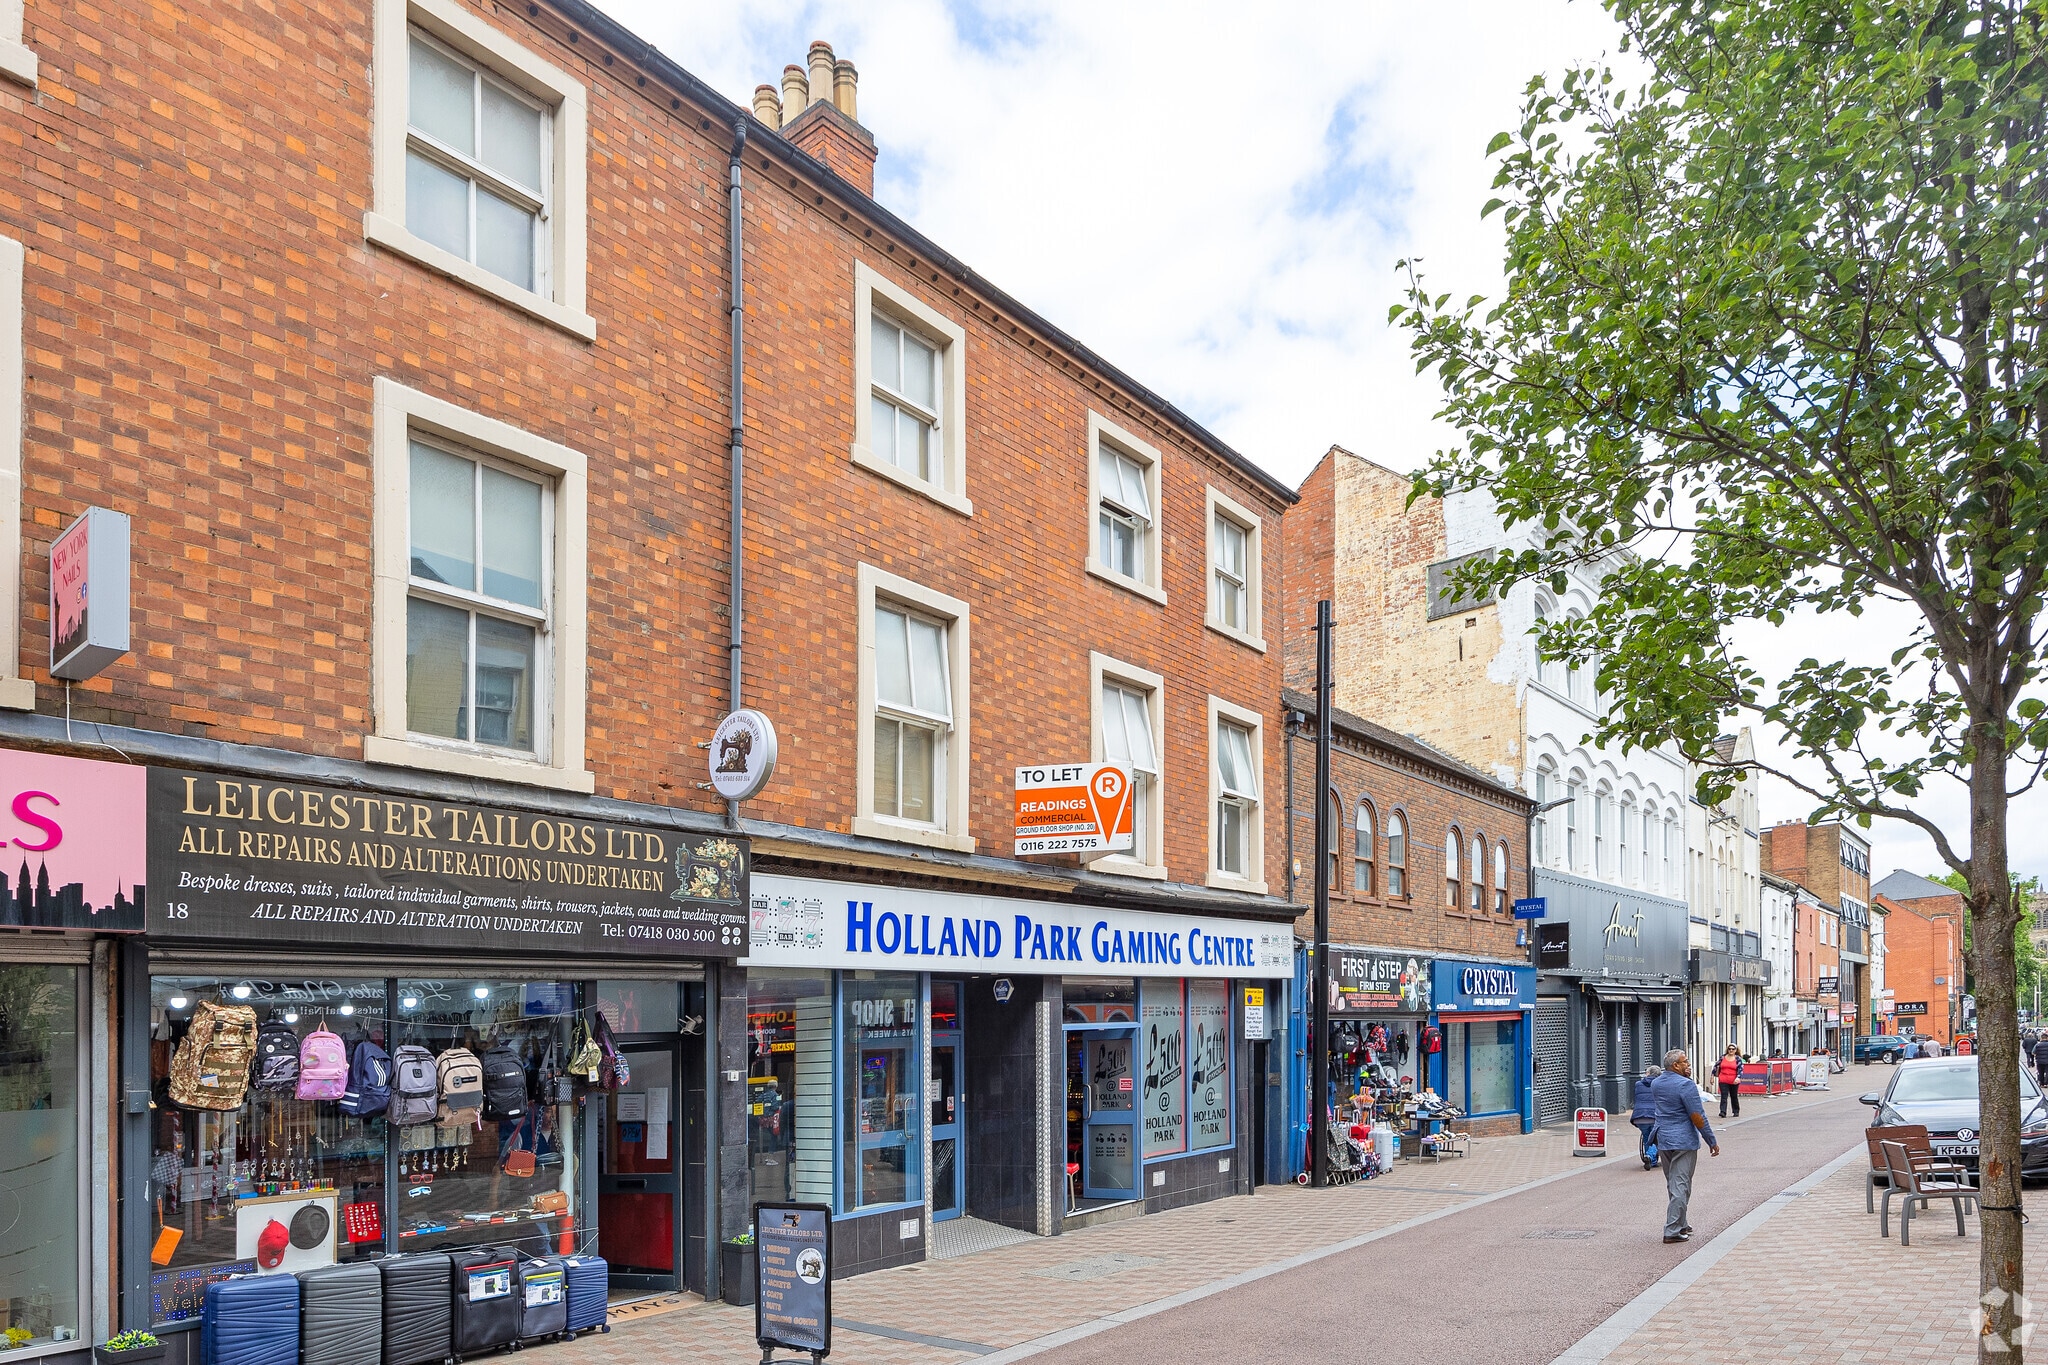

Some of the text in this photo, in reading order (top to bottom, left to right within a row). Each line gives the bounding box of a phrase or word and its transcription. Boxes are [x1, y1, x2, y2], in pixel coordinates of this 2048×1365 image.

[53, 528, 88, 574] NEW YORK
[63, 560, 80, 591] NAILS
[715, 717, 736, 745] LEICESTER
[737, 715, 755, 730] TAILORS
[1021, 768, 1082, 783] TO LET
[1102, 777, 1115, 792] R
[1020, 799, 1087, 813] READINGS
[0, 790, 63, 852] S
[182, 776, 668, 864] LEICESTER TAILORS LTD.
[1021, 813, 1086, 824] COMMERCIAL
[1016, 826, 1039, 834] GROUND
[1058, 824, 1073, 832] SHOP
[1021, 839, 1097, 851] 0116 222 7575
[178, 826, 664, 892] ALL REPAIRS AND ALTERATIONS UNDERTAKEN
[178, 871, 241, 893] Bespoke
[244, 875, 296, 896] dresses,
[301, 880, 333, 896] suits
[344, 883, 395, 901] tailored
[397, 886, 461, 904] individual
[463, 895, 518, 911] garments,
[521, 895, 553, 913] shirts,
[556, 900, 598, 916] trousers,
[599, 901, 635, 918] jackets,
[638, 906, 660, 918] coats
[663, 907, 680, 920] and
[682, 908, 719, 925] wedding
[720, 914, 747, 926] gowns.
[167, 902, 189, 919] 18
[250, 903, 583, 935] ALL REPAIRS AND ALTERATION UNDERTAKEN
[600, 923, 716, 942] Tel: 07418 030 500
[846, 900, 1255, 967] HOLLAND PARK GAMING CENTRE
[1341, 957, 1402, 979] FIRST STEP
[1360, 981, 1375, 991] FIRM
[1375, 982, 1391, 991] STEP
[1464, 967, 1518, 995] CRYSTAL
[1898, 1002, 1925, 1010] RORA
[1145, 1114, 1183, 1130] HOLLAND
[1193, 1108, 1227, 1122] HOLLAND
[1154, 1130, 1175, 1142] PARK
[1201, 1122, 1220, 1135] PARK
[1941, 1147, 1968, 1155] KF64
[761, 1226, 786, 1235] LEICESTER
[787, 1229, 810, 1237] TAILORS
